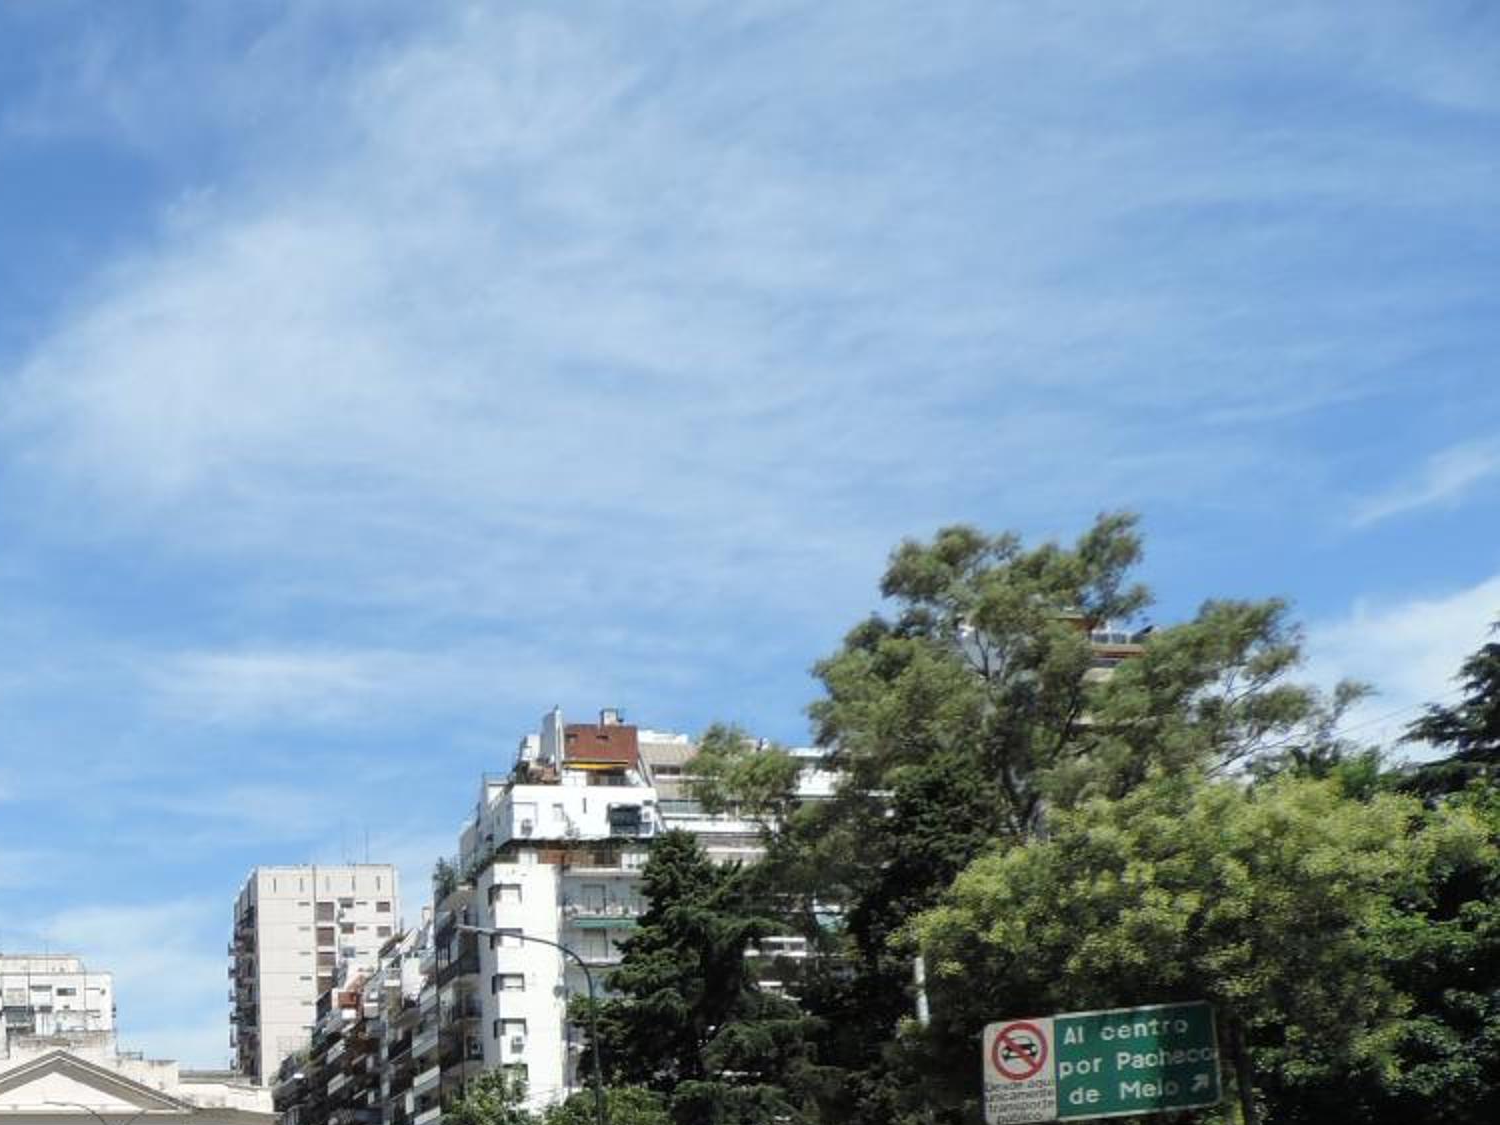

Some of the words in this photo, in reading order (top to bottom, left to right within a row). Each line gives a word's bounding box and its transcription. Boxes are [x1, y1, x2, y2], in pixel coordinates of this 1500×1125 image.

[1063, 1026, 1084, 1045] Al
[1100, 1017, 1189, 1042] centro
[1059, 1057, 1102, 1080] por
[1116, 1047, 1217, 1071] Pacheco
[1069, 1085, 1100, 1105] de
[1119, 1077, 1180, 1100] Melo
